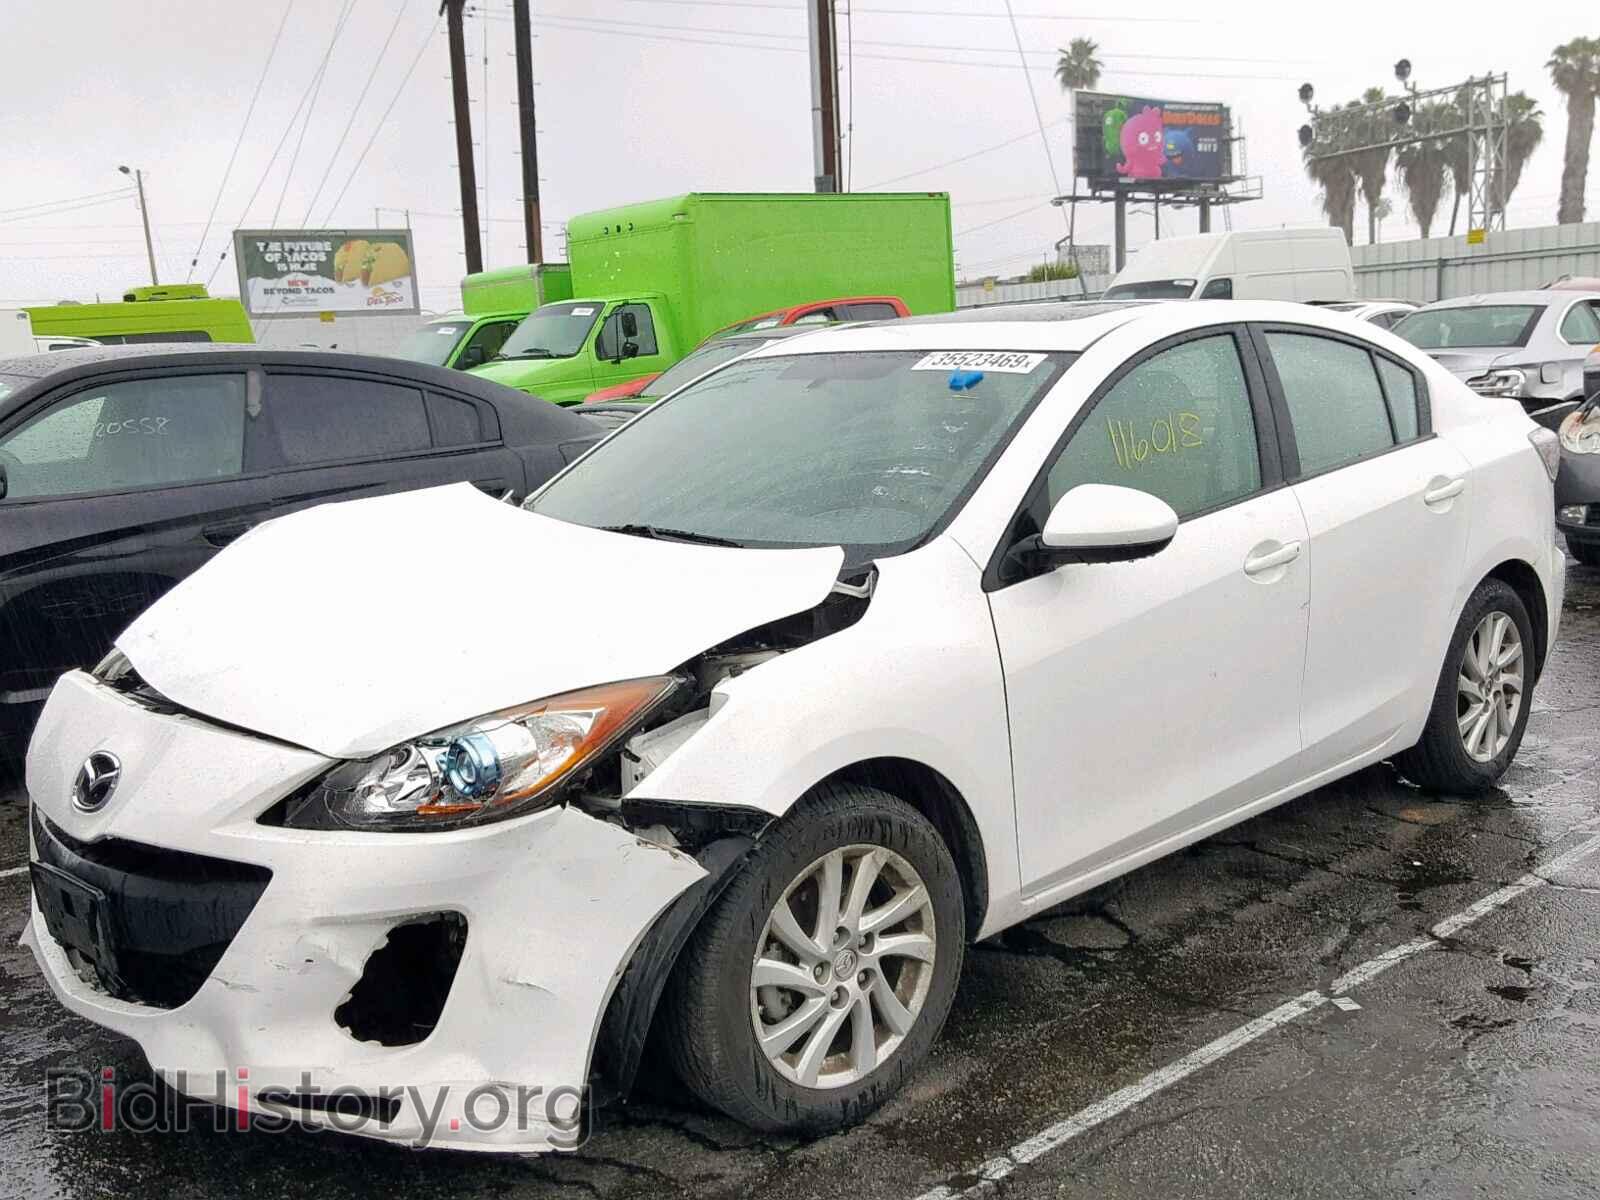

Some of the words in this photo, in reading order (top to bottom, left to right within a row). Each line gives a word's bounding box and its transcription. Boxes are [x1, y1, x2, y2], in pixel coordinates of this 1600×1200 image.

[264, 252, 282, 263] OF
[283, 251, 327, 262] TACOS
[263, 287, 302, 295] BEYOND
